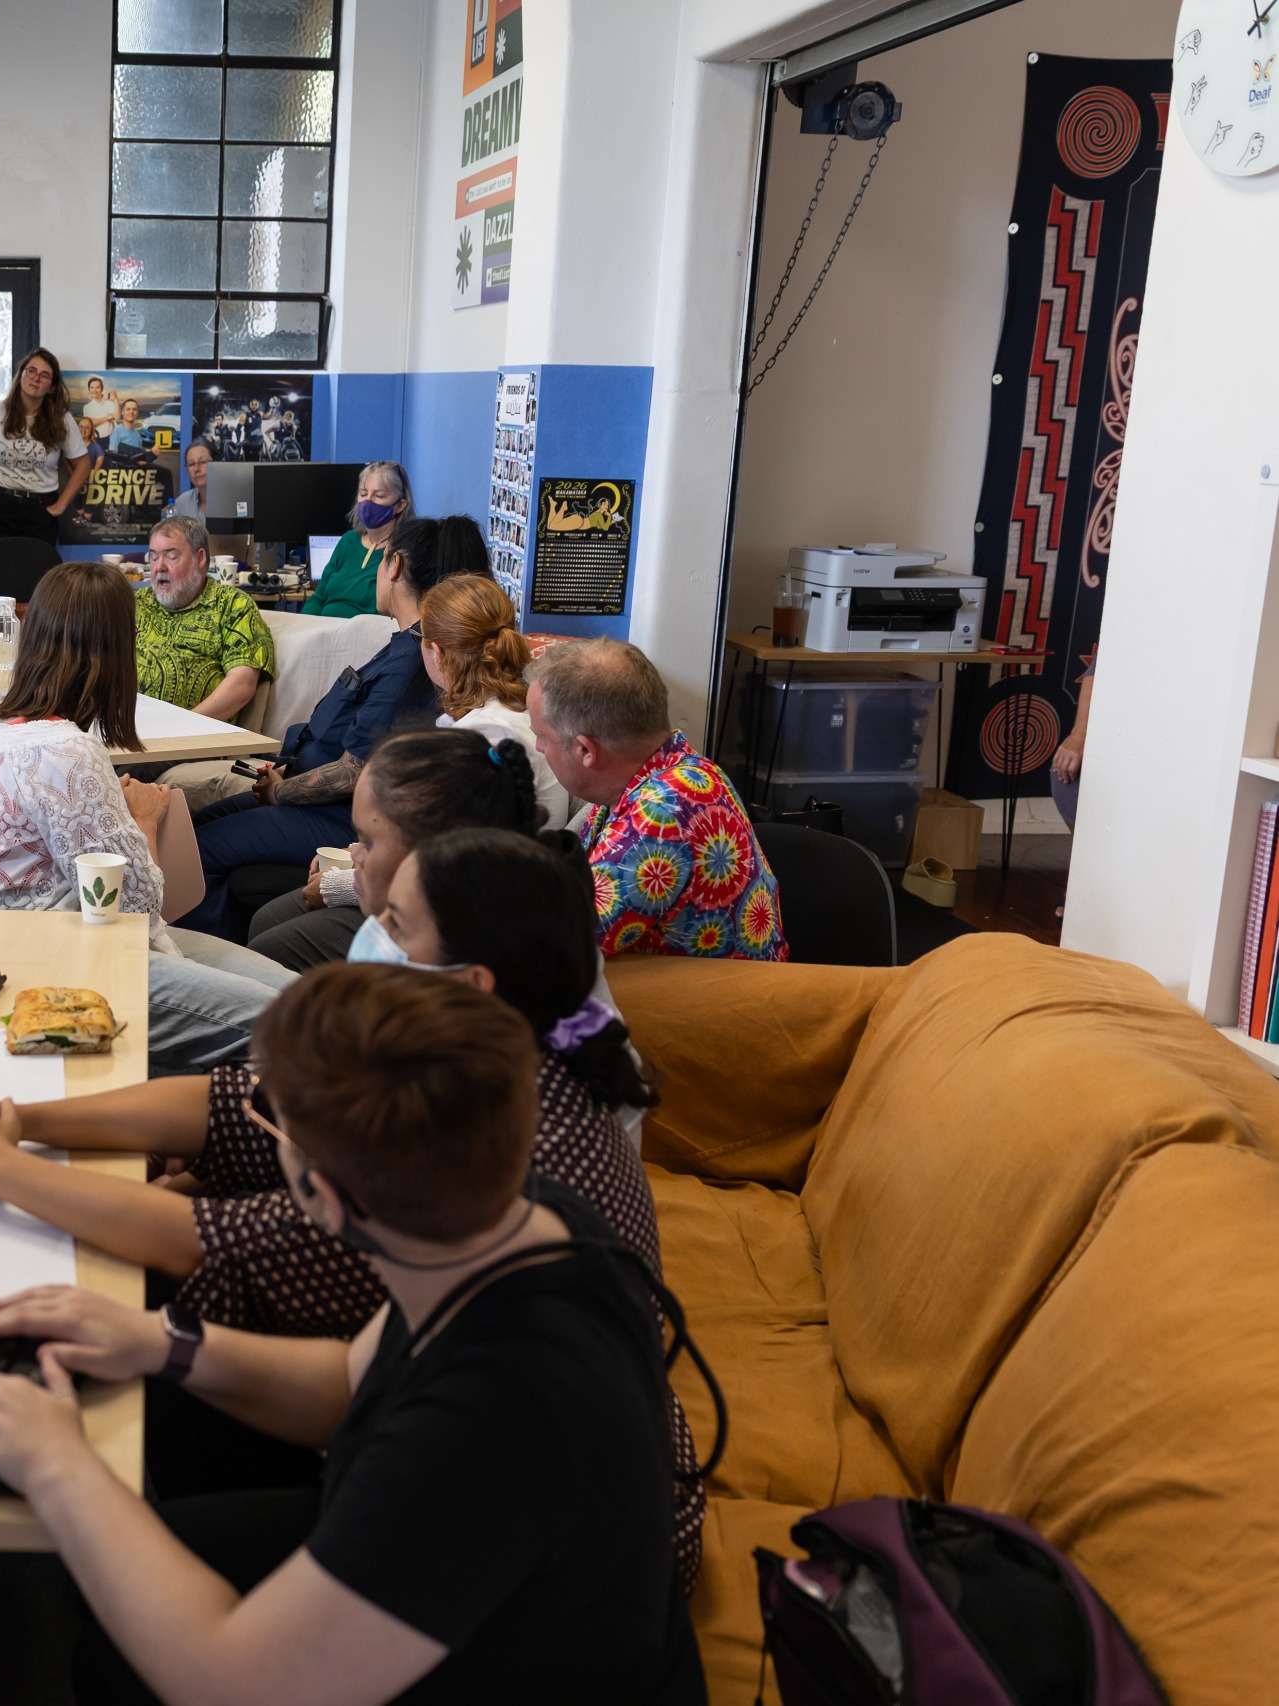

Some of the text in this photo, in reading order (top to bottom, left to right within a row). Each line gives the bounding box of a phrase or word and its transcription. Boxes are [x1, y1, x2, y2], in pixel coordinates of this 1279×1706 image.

[472, 29, 488, 62] LIST
[1249, 85, 1272, 102] Deaf
[462, 76, 523, 168] DREAMY
[506, 385, 526, 395] FRIENDS OF
[160, 432, 169, 446] L
[85, 469, 157, 484] ICENCE
[555, 481, 588, 489] 2026
[86, 485, 165, 504] DRIVE
